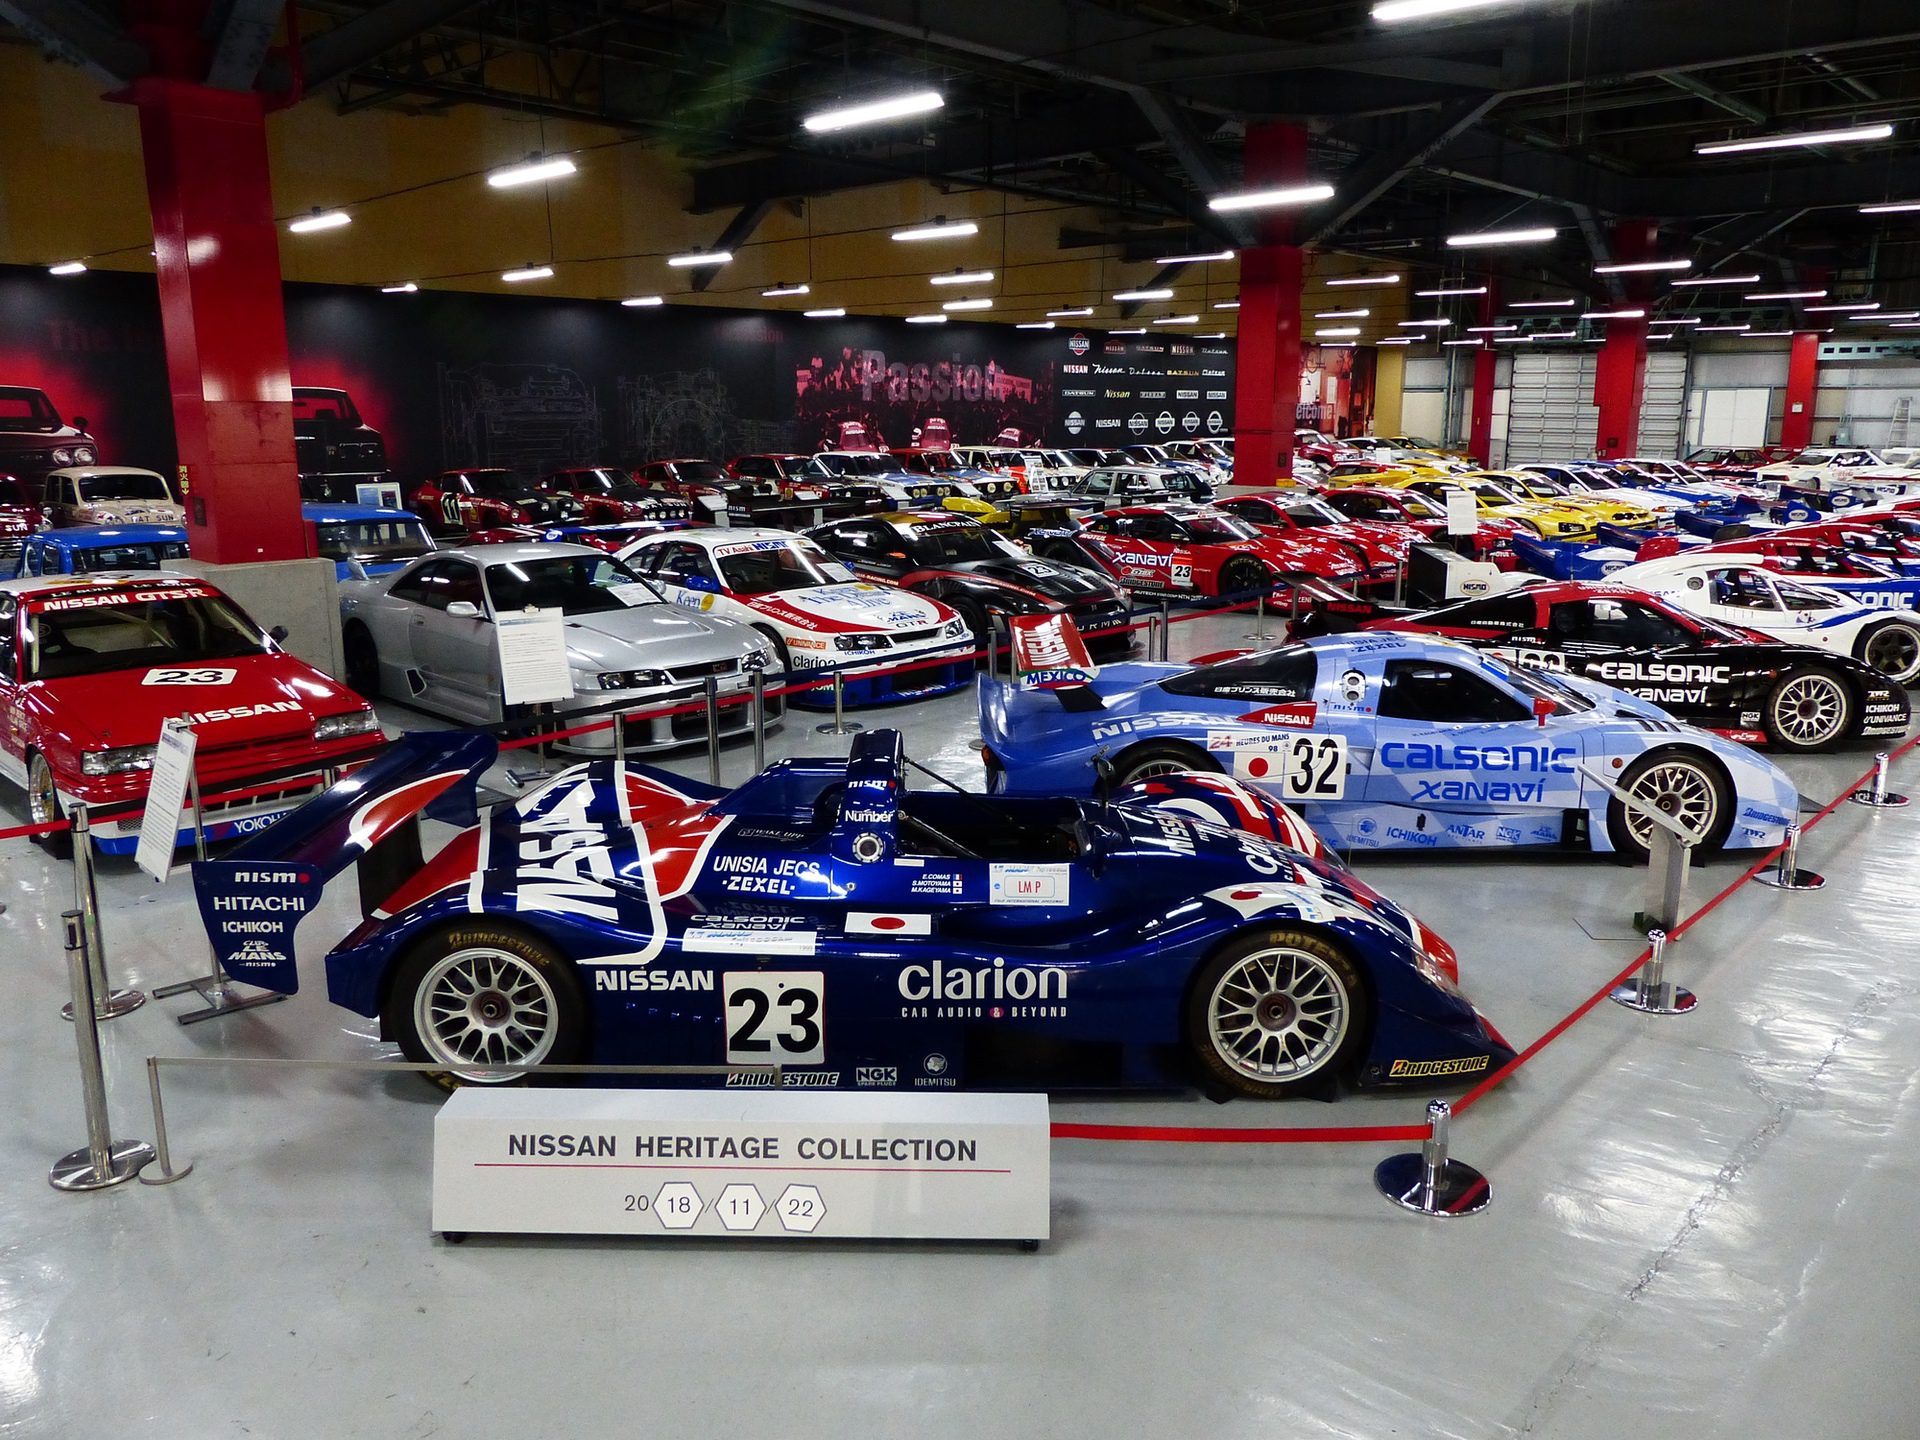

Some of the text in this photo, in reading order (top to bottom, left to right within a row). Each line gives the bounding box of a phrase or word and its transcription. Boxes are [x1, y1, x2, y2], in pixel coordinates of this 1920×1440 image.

[1069, 338, 1090, 349] NISSAN
[863, 350, 1003, 401] Passion
[1063, 364, 1088, 374] NISSAN
[1104, 389, 1131, 398] Nissan
[1177, 391, 1198, 399] NISSAN
[1064, 418, 1086, 427] NISSAN
[1096, 419, 1121, 428] NISSAN
[1129, 420, 1148, 428] NISSAN
[156, 513, 174, 522] SUN
[5, 524, 28, 532] SUN
[915, 520, 981, 534] BLANCPAIN
[1029, 564, 1050, 575] 23
[1174, 565, 1191, 578] 23
[1463, 583, 1487, 591] NISMO
[44, 594, 129, 611] NISSAN
[154, 670, 224, 683] 23
[1026, 671, 1086, 685] MEXICO
[1214, 686, 1296, 697] 日産プリンス販売会社
[167, 700, 304, 726] NISSAN
[1866, 703, 1900, 713] ICHIKOH
[1264, 713, 1311, 725] NISSAN
[1742, 712, 1759, 720] NGK
[1091, 713, 1243, 740] NISSAN
[1209, 733, 1290, 749] 24 HEURES DU MANS
[1291, 738, 1339, 794] 32
[845, 810, 893, 823] Number
[1387, 827, 1437, 846] ICHIKOH
[1446, 824, 1485, 840] ANTAR
[1497, 827, 1520, 839] NGK
[713, 855, 821, 877] UNISIA JECS
[1018, 881, 1041, 893] LM P
[214, 896, 305, 911] HITACHI
[222, 921, 284, 933] ICHIKOH
[227, 952, 287, 961] MANS
[595, 970, 714, 991] NISSAN
[901, 1007, 929, 1018] CAR
[937, 1007, 982, 1018] AUDIO
[1011, 1006, 1068, 1018] BEYOND
[728, 988, 823, 1053] 23
[1389, 1055, 1491, 1077] BRIDGESTONE
[726, 1072, 840, 1087] BRIDESTONE
[857, 1068, 897, 1083] NGK
[914, 1078, 956, 1087] IDEMITSU
[508, 1135, 978, 1161] NISSAN HERITAGE COLLECTION
[625, 1195, 813, 1216] 20 18 11 22
